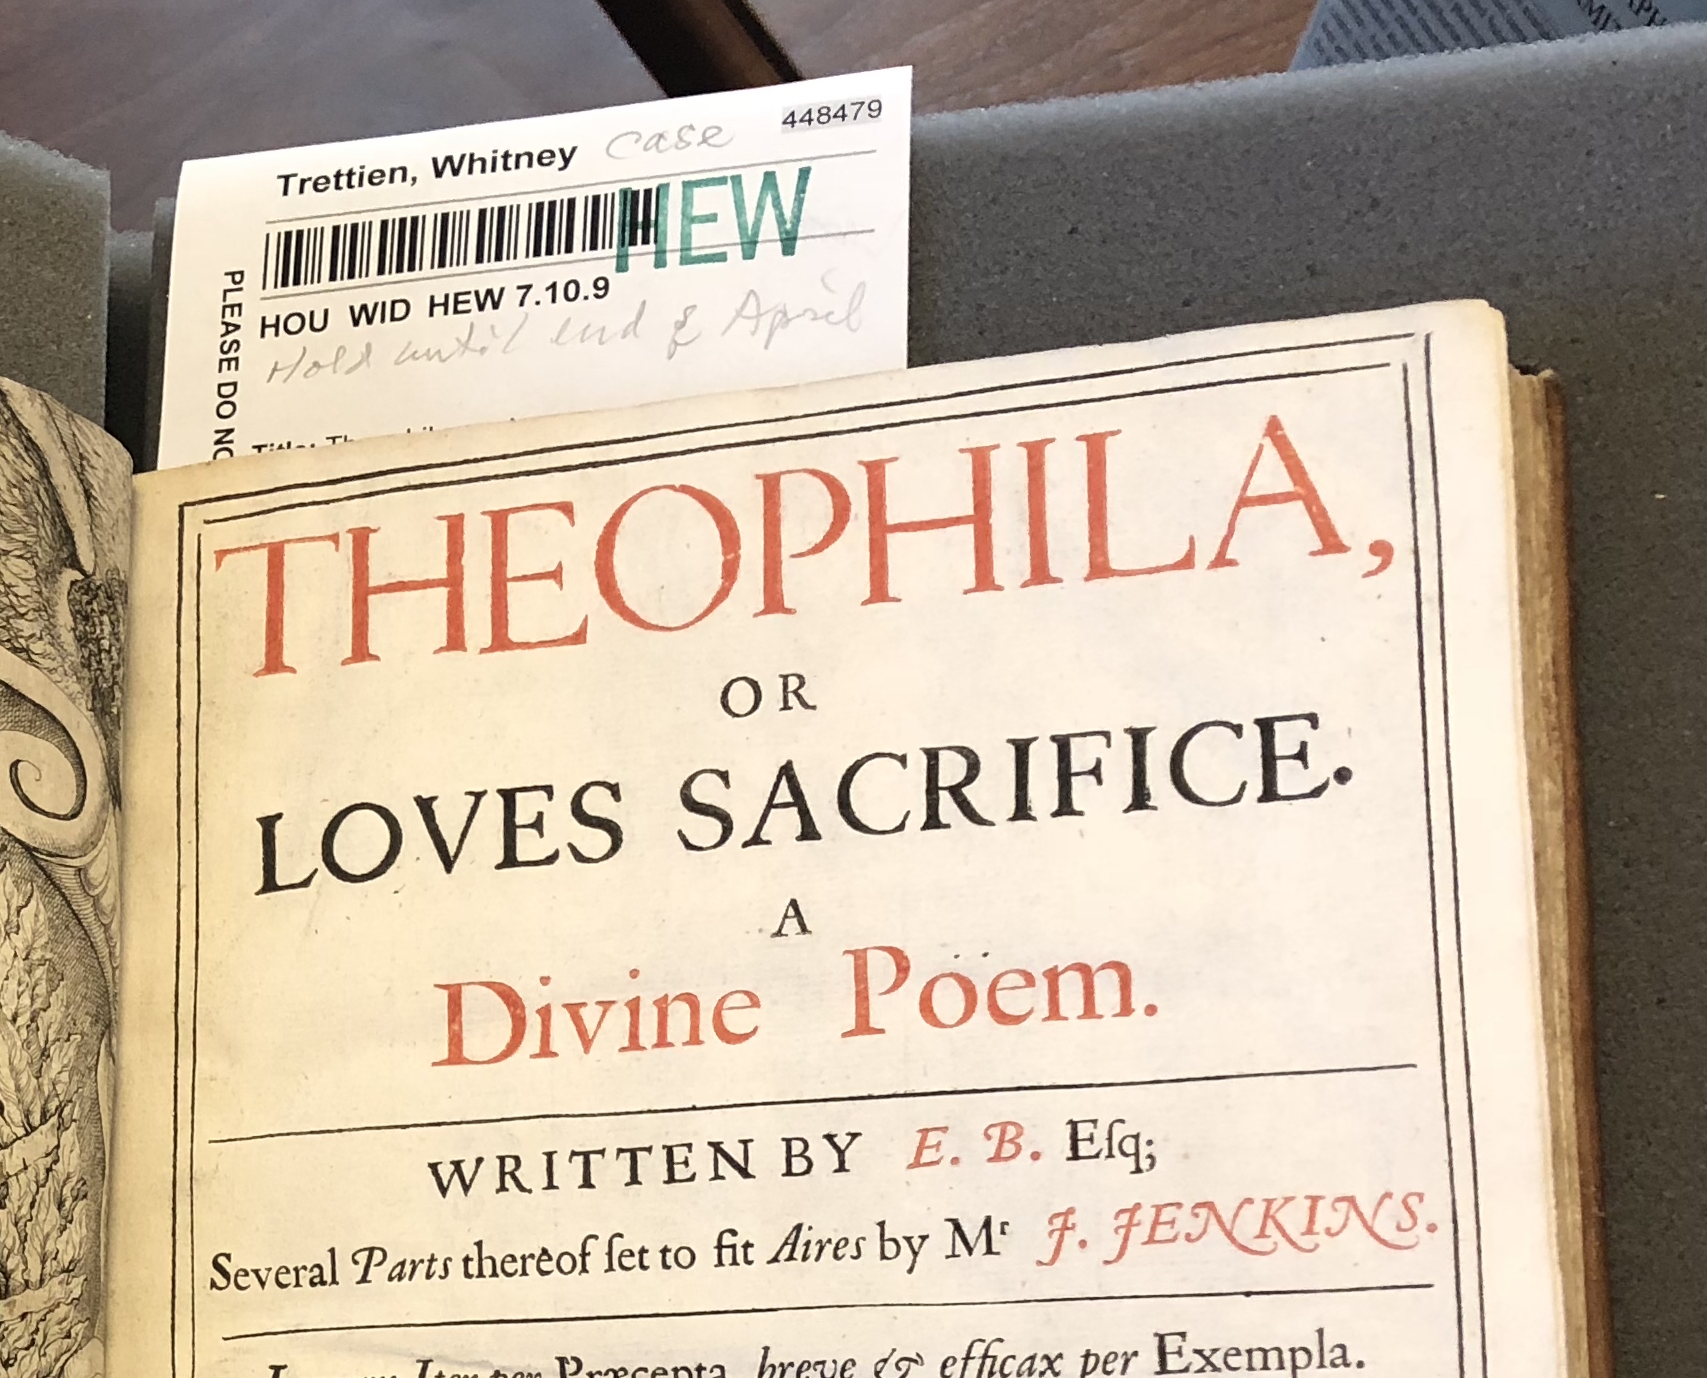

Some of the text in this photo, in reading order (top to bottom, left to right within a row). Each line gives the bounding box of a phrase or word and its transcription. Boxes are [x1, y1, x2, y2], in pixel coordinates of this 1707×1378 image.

[782, 99, 883, 129] 448479
[278, 144, 578, 198] Trettien, Whitney
[615, 166, 812, 273] HEW
[218, 270, 244, 374] PLEASE
[260, 276, 609, 339] HOU WID HEW 7.10.9
[266, 342, 372, 384] Hold
[216, 381, 238, 420] DO
[213, 413, 1394, 678] THEOPHILA,
[720, 673, 817, 718] OR
[256, 711, 1353, 895] LOVES SACRIFICE.
[771, 898, 812, 938] A
[431, 969, 761, 1068] Divine
[427, 1139, 758, 1199] WRITTEN
[781, 1132, 862, 1178] BY
[906, 1127, 959, 1170] E.
[983, 1121, 1041, 1163] B.
[209, 1249, 339, 1292] Several
[351, 1246, 452, 1284] Parts
[660, 1244, 696, 1270] to
[714, 1229, 754, 1267] fit
[768, 1223, 865, 1264] Aires
[879, 1222, 928, 1275] by
[1103, 1192, 1438, 1265] JENKINS.
